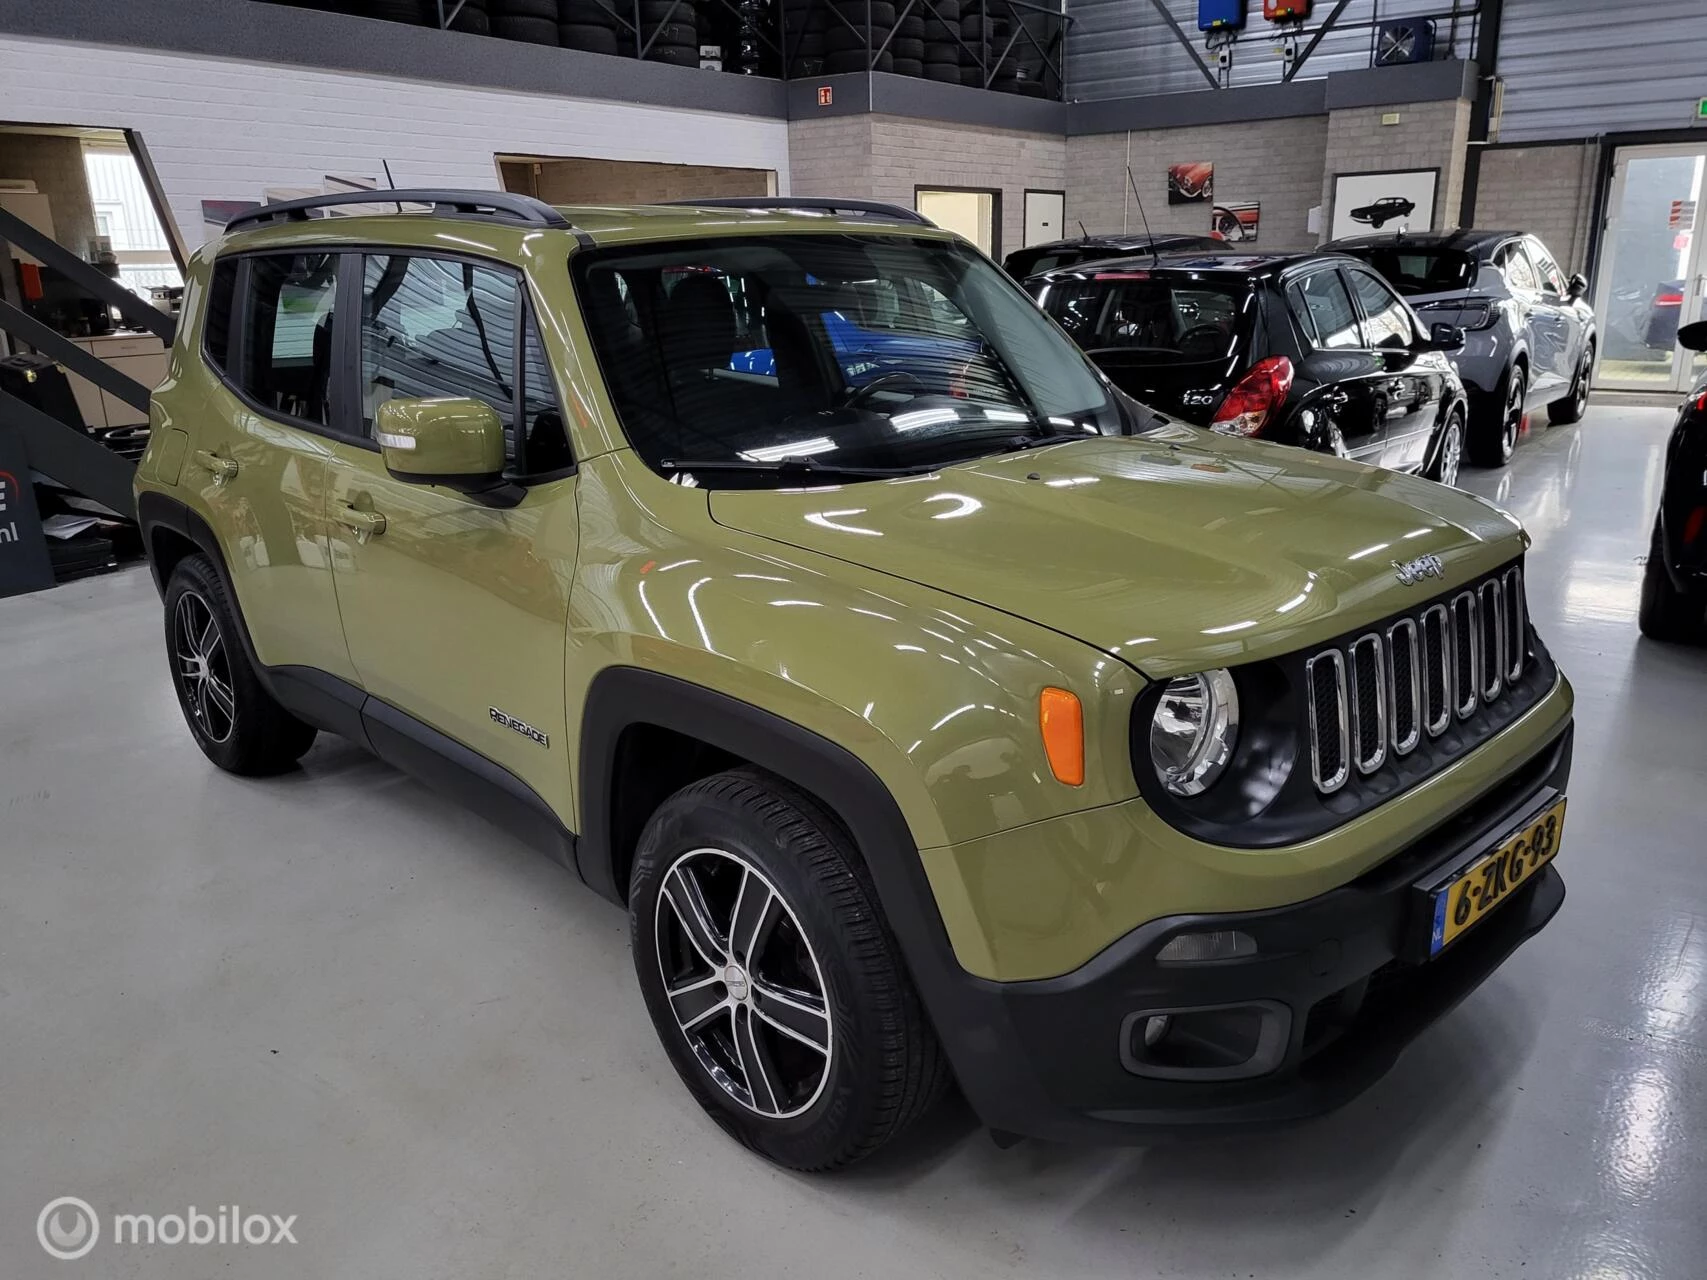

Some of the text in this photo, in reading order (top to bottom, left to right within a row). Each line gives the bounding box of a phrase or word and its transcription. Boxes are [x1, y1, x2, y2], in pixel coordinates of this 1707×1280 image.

[1183, 390, 1213, 405] i20
[1392, 554, 1443, 586] Jeep
[488, 705, 549, 748] RENEGADE
[1454, 814, 1557, 926] 6-ZKG-93
